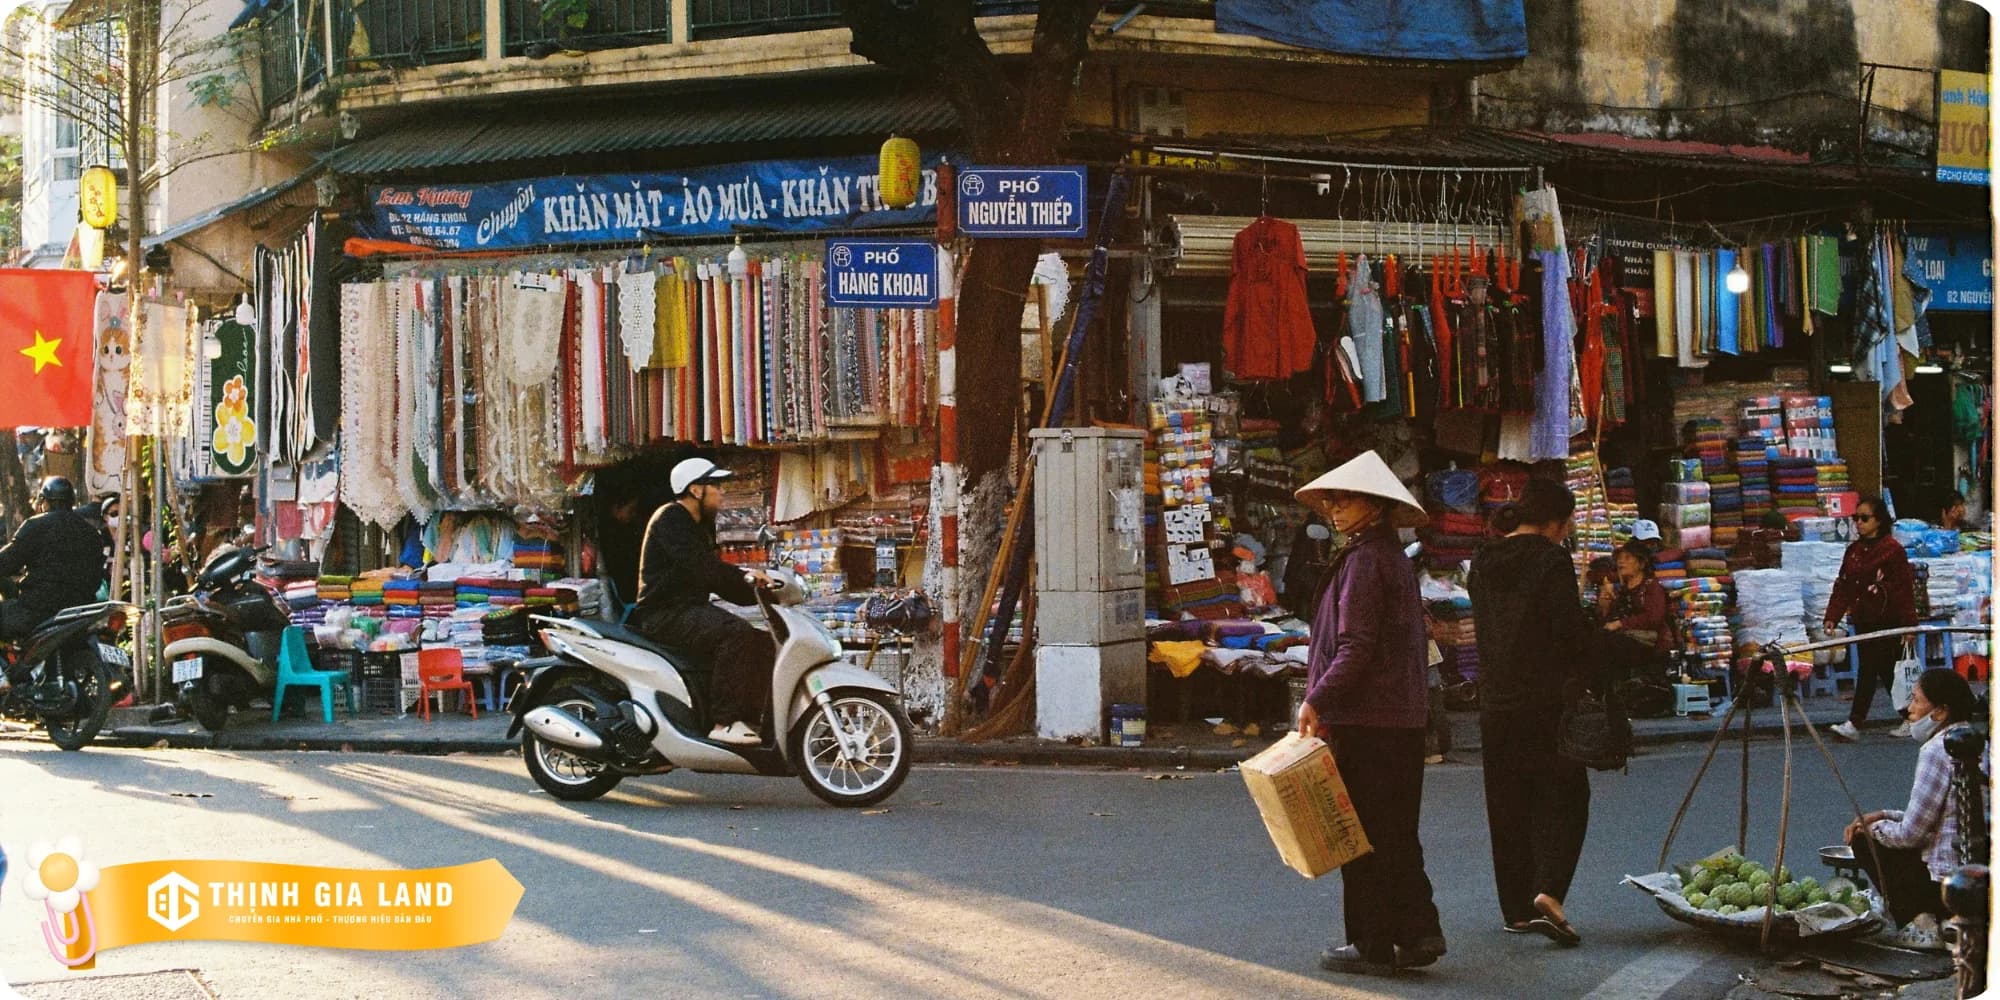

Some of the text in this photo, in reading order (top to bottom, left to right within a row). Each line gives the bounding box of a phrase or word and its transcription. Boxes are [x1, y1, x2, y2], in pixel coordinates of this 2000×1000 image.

[999, 175, 1041, 193] PHỐ
[476, 184, 537, 245] Chuyên
[544, 182, 609, 233] KHĂN
[613, 180, 663, 241] MẶT
[717, 175, 768, 221] MƯA
[781, 165, 850, 218] KHĂN
[968, 195, 1073, 225] NGUYỄN THIẾP
[864, 246, 900, 264] PHỐ
[839, 267, 928, 296] HÀNG KHOAI
